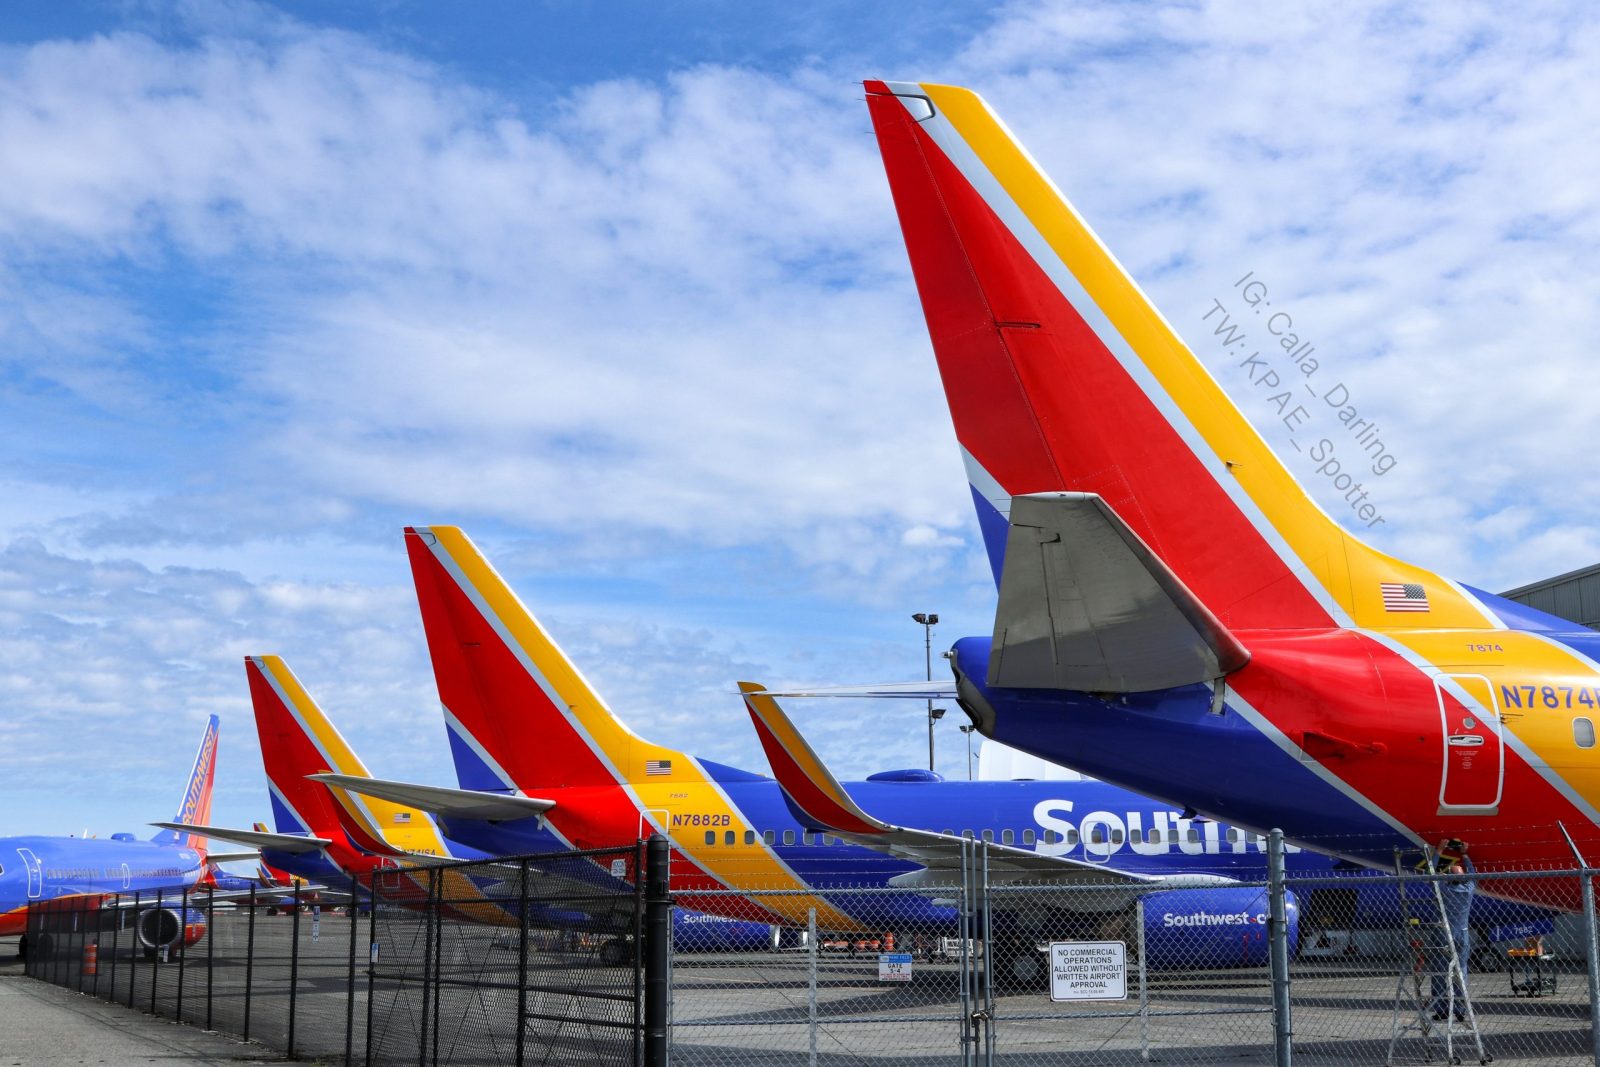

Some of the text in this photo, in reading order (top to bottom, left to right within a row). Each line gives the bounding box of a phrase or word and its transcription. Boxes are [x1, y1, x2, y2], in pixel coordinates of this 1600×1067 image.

[1466, 643, 1504, 652] 7874
[673, 814, 731, 826] N7882B
[1070, 948, 1117, 956] COMMERCIAL
[1063, 956, 1112, 964] OPERATIONS
[1090, 964, 1123, 972] WITHOUT
[1056, 972, 1121, 981] WRITTEN AIRPORT
